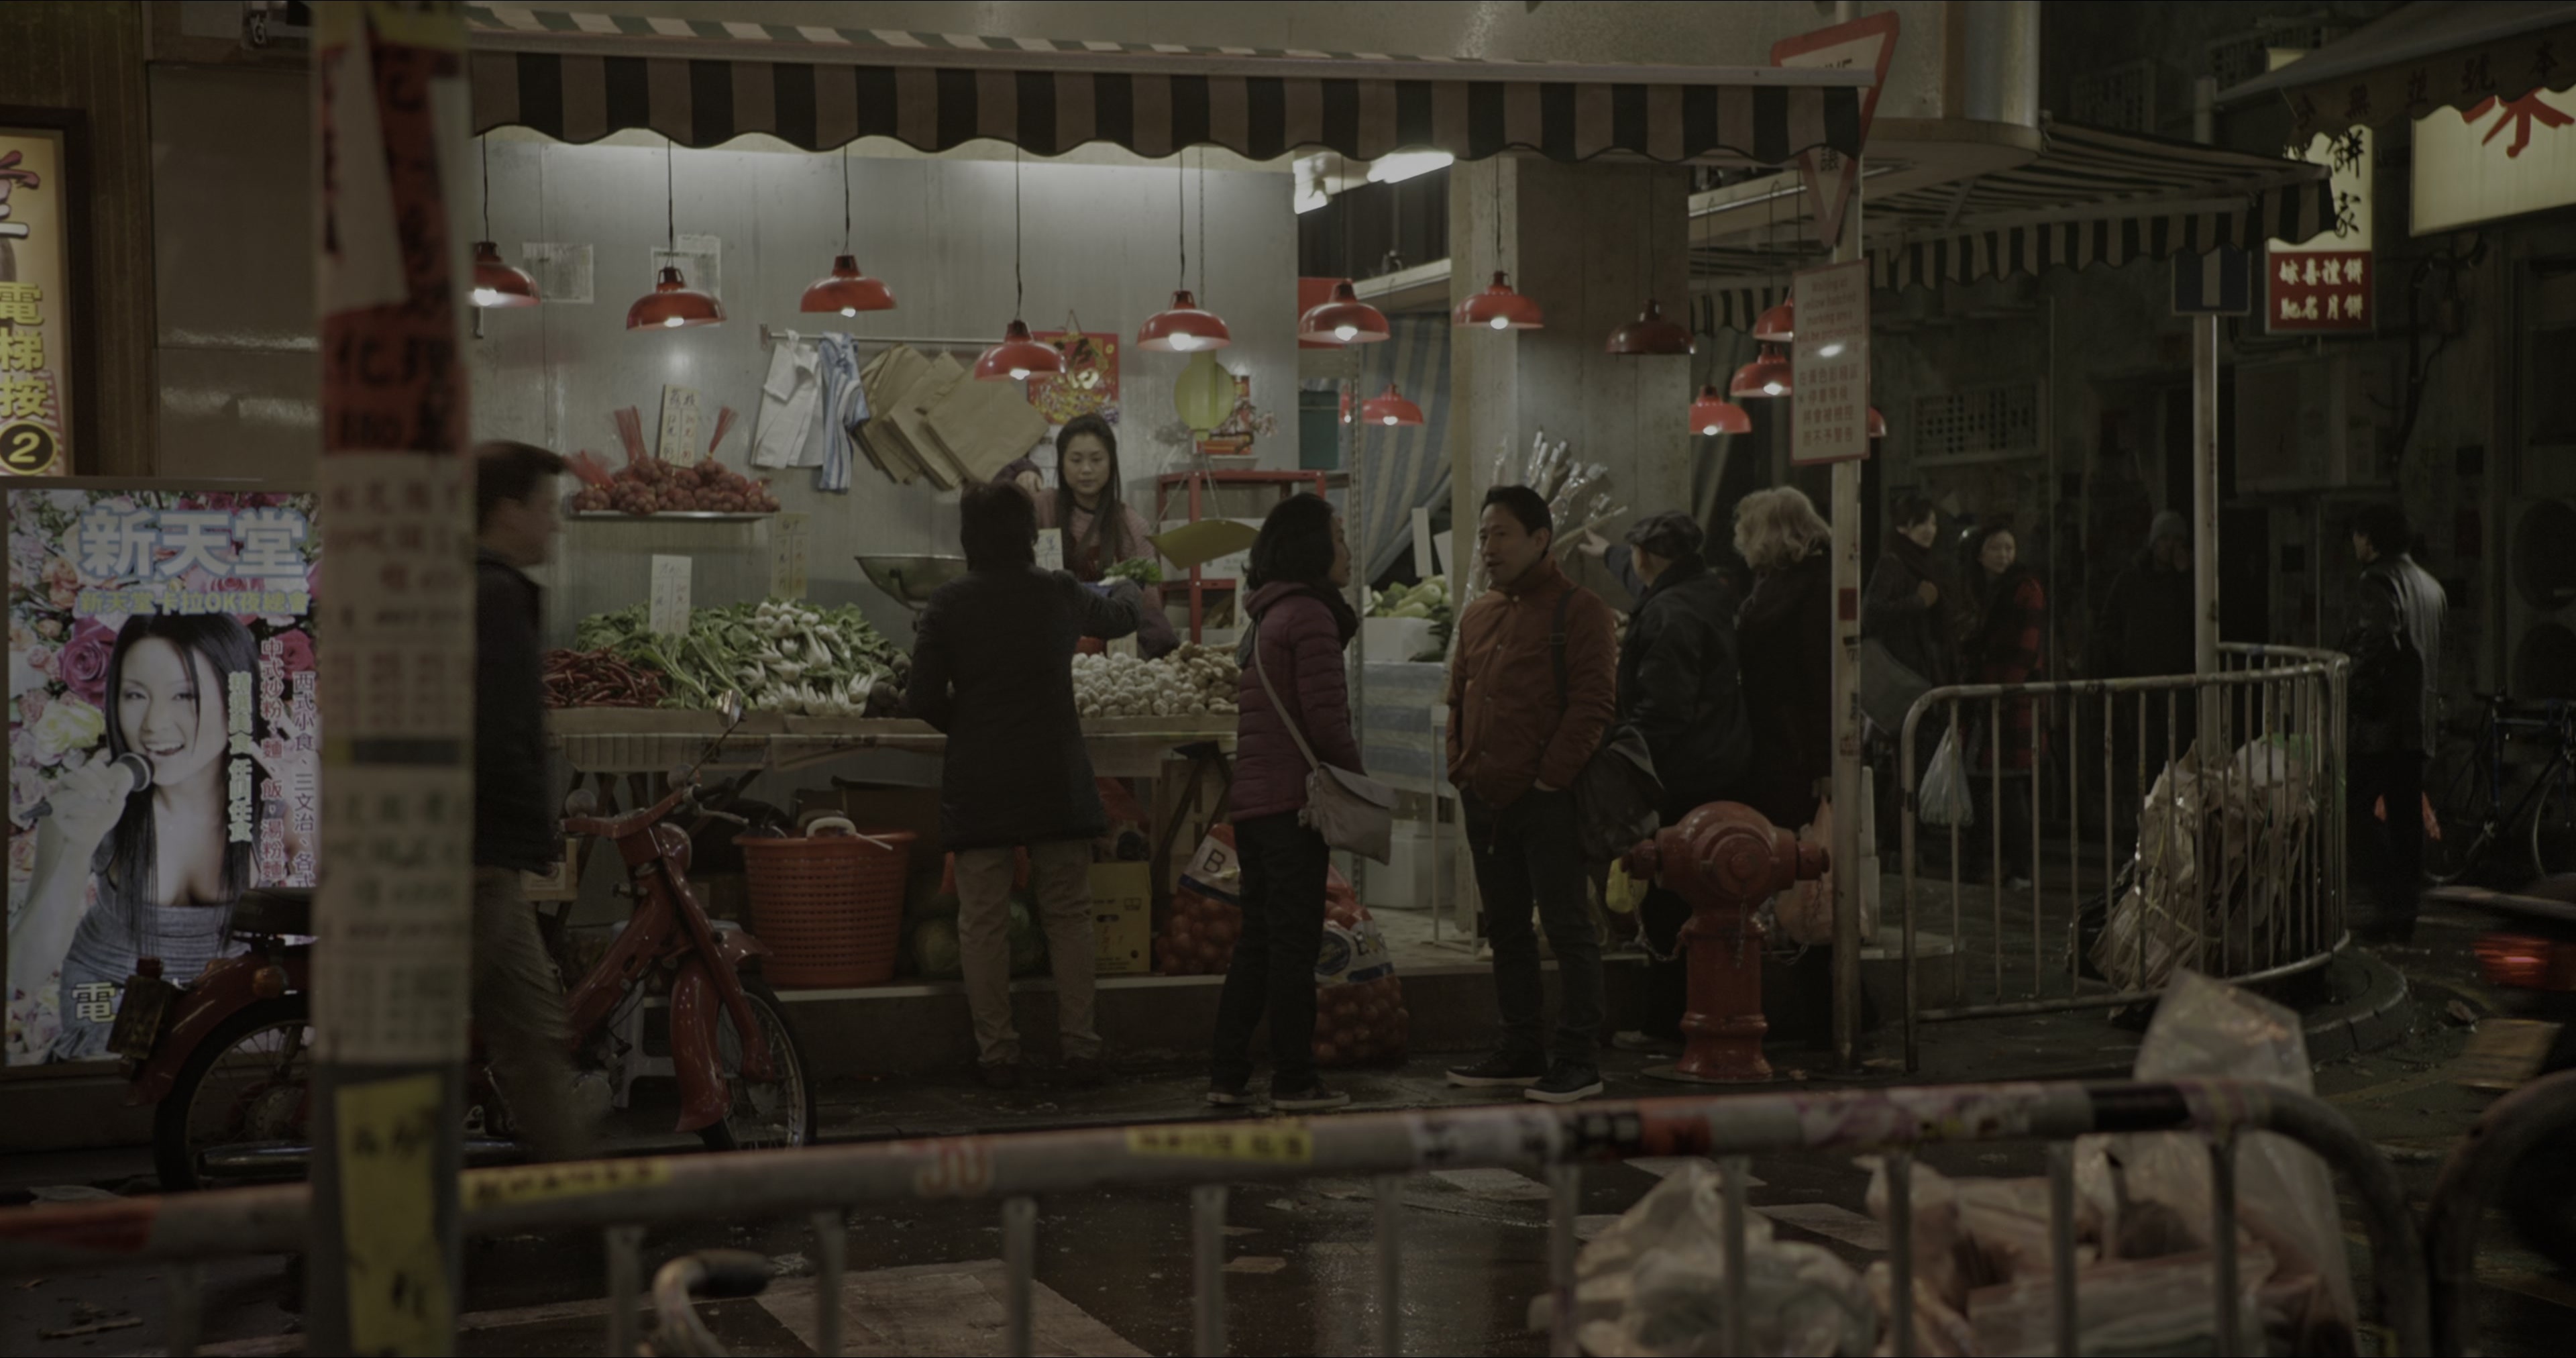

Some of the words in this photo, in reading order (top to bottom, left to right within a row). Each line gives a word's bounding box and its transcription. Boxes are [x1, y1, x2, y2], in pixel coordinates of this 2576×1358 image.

[78, 505, 308, 579] 新天堂
[78, 590, 311, 615] 新天堂卡拉OK夜總會
